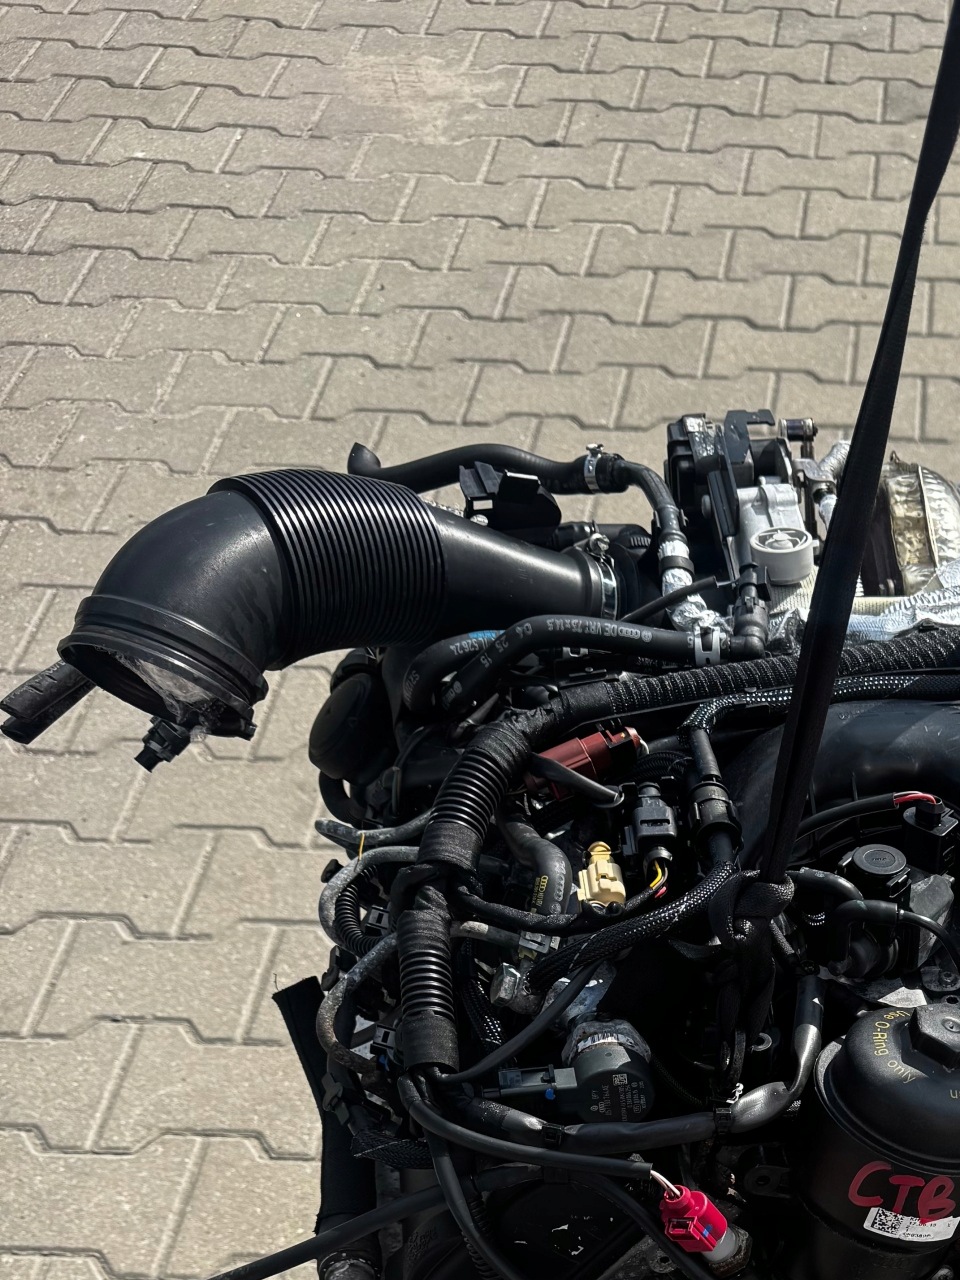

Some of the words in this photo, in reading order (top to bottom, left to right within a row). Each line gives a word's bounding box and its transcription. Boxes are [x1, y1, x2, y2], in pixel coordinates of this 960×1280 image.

[883, 1010, 911, 1021] Use
[872, 1021, 890, 1056] O-Ring
[887, 1060, 916, 1084] only
[848, 1160, 956, 1225] CTB
